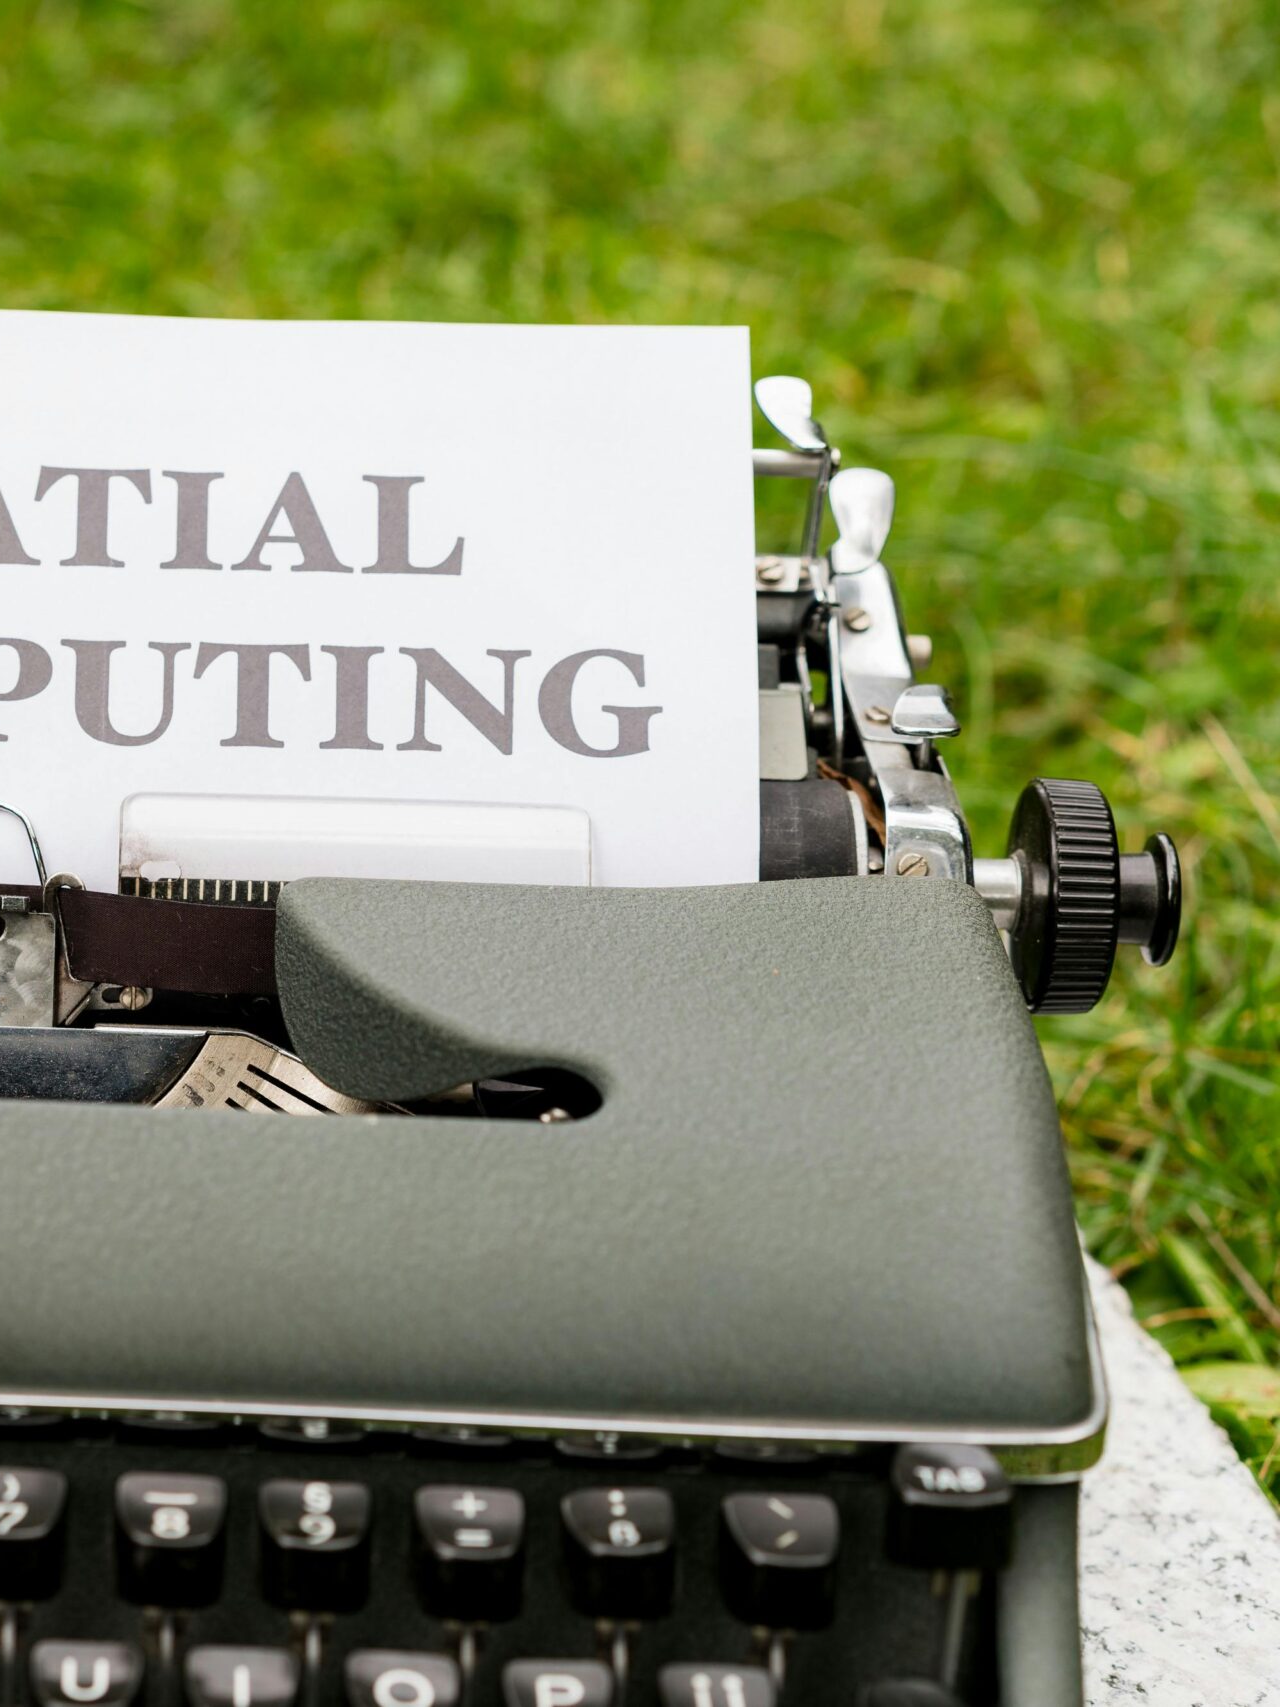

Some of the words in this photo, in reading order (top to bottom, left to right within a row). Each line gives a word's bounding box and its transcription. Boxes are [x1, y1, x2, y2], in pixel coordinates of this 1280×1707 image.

[914, 1464, 987, 1493] TAB
[151, 1506, 190, 1539] 8
[298, 1513, 336, 1546] 9
[59, 1656, 110, 1701] U
[534, 1673, 586, 1707] P
